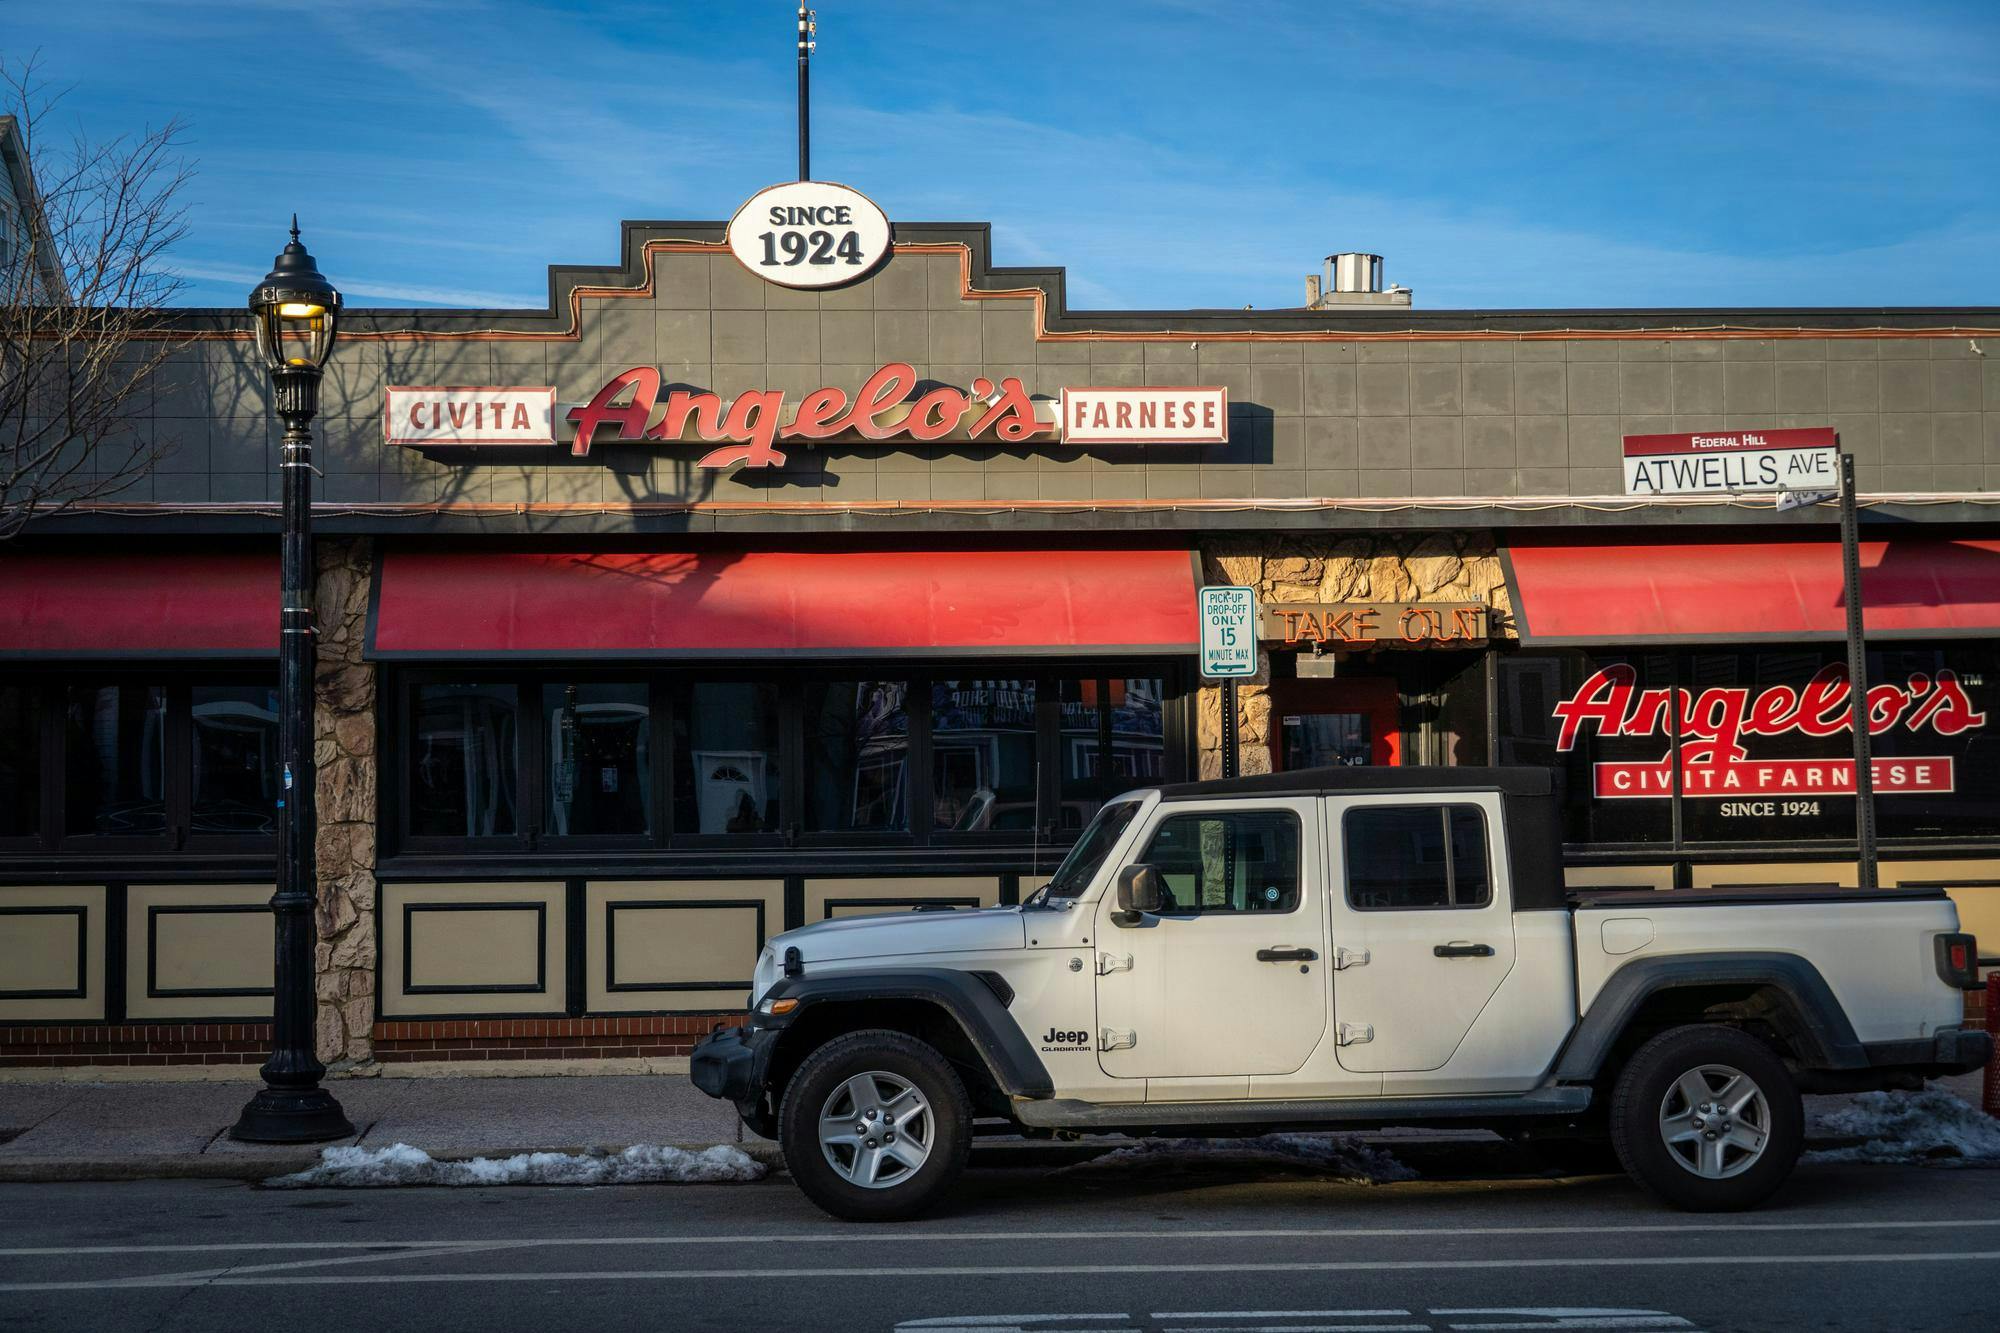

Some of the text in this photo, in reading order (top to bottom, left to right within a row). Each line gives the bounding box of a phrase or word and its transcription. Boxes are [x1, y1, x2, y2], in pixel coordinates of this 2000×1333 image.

[769, 205, 852, 226] SINCE
[758, 230, 864, 266] 1924
[409, 401, 531, 430] CIVITA
[565, 362, 1056, 469] Angelo's
[1075, 401, 1215, 429] FARNESE
[1632, 452, 1829, 491] ATWELLS AVE
[1207, 604, 1247, 615] DROP-OFF
[1210, 593, 1243, 603] PICK-UP
[1212, 615, 1245, 626] ONLY
[1272, 608, 1482, 643] TAKE OUT
[1220, 627, 1236, 646] 15
[1208, 649, 1249, 661] MINUTE MAX
[1552, 663, 1985, 765] Angelo's
[1613, 765, 1931, 790] CIVITA FARNESE
[1720, 802, 1820, 817] SINCE 1924
[1043, 1027, 1088, 1045] Jeep
